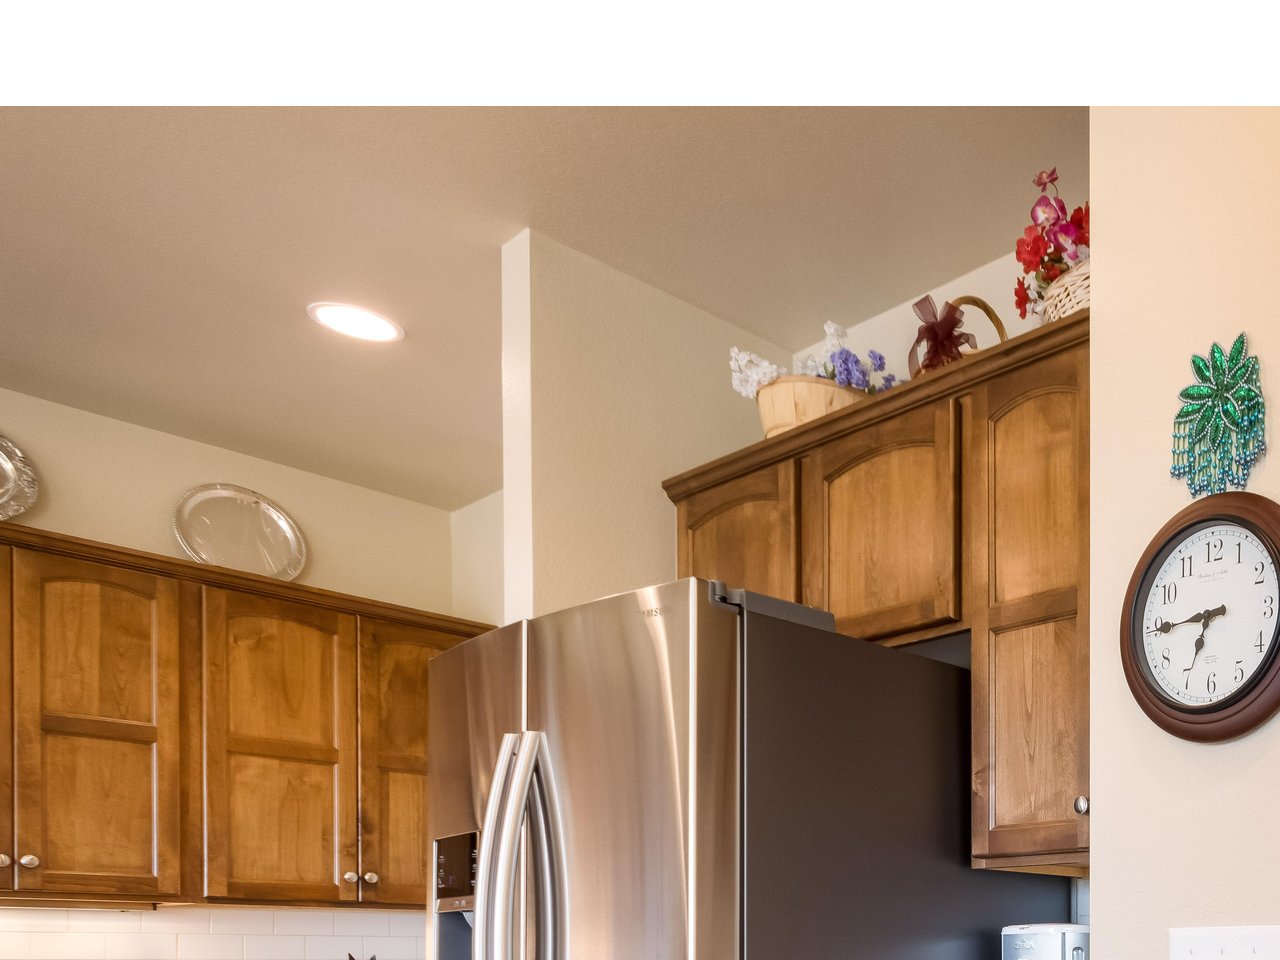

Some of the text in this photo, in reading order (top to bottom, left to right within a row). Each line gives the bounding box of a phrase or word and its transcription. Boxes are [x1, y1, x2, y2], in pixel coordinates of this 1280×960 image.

[1204, 538, 1224, 563] 12
[1235, 542, 1243, 564] 1
[1179, 555, 1194, 578] 11
[1254, 561, 1265, 585] 2
[1161, 582, 1177, 605] 10
[1263, 595, 1274, 619] 3
[1154, 616, 1163, 638] 9
[1253, 630, 1265, 653] 4
[1161, 647, 1171, 670] 8
[1182, 667, 1192, 690] 7
[1206, 671, 1216, 694] 6
[1234, 660, 1244, 683] 5
